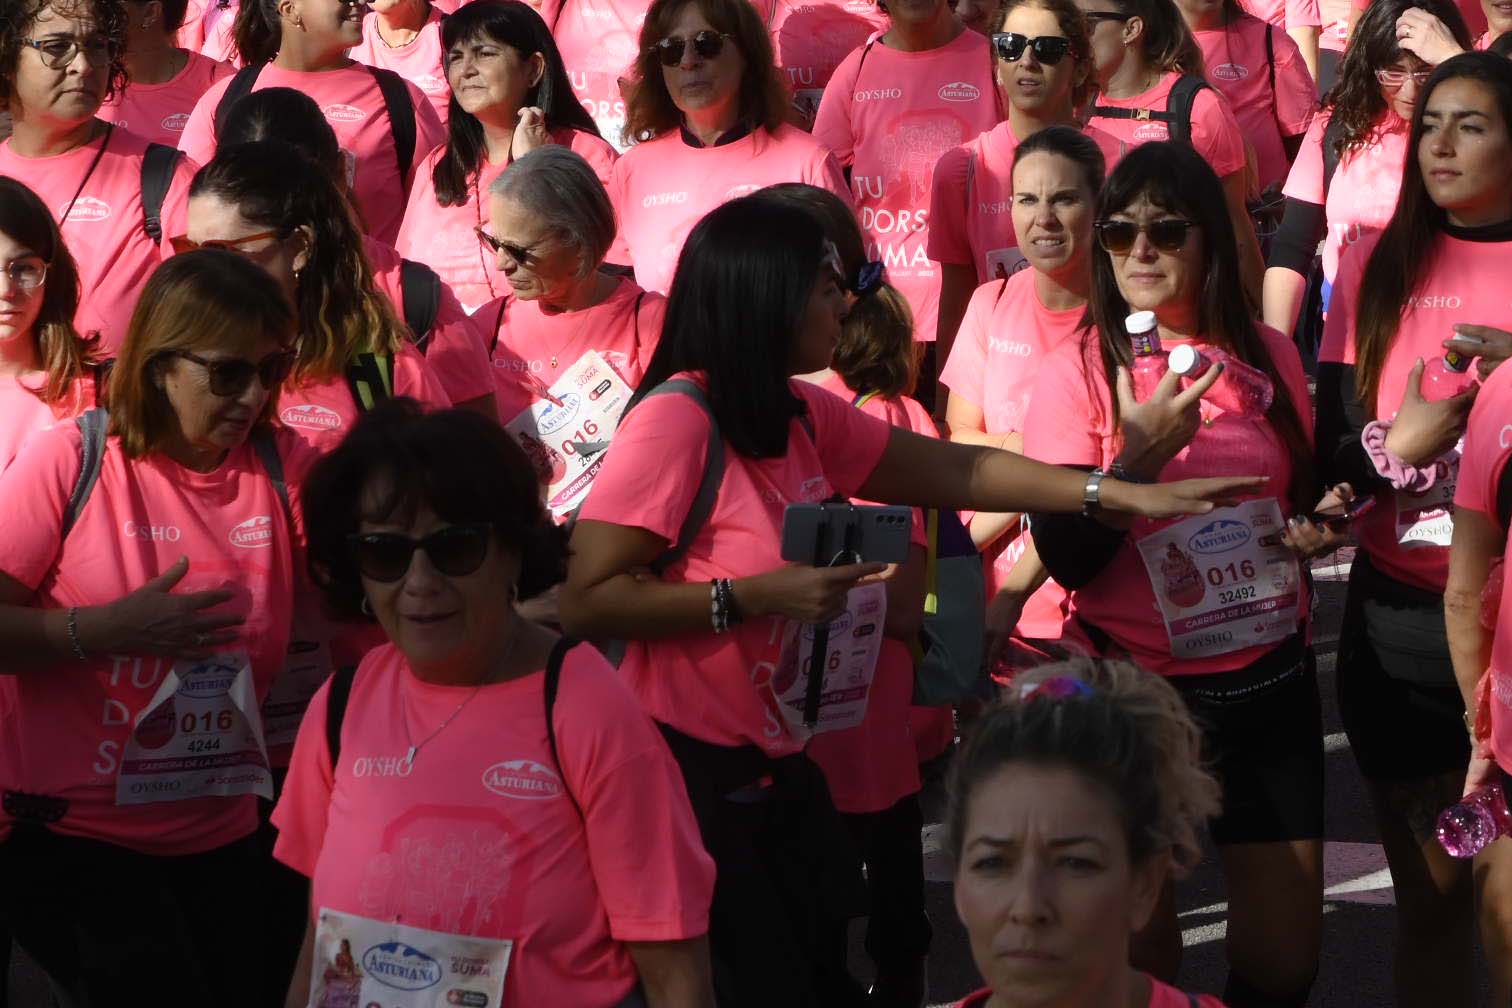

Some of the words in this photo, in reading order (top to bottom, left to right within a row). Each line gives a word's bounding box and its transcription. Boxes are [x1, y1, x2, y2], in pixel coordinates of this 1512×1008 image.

[787, 67, 813, 85] TU
[855, 87, 902, 103] OYSHO
[940, 86, 978, 97] ASTURIANA
[853, 175, 883, 198] TU
[642, 192, 687, 208] OYSHO
[862, 205, 929, 233] DORS
[494, 358, 543, 373] OYSHO
[285, 412, 337, 426] ASTURIANA
[561, 419, 598, 456] 016
[561, 474, 591, 502] CARRERA
[588, 464, 600, 478] DE
[1194, 529, 1249, 549] ASTURIANA
[1206, 559, 1256, 586] 016
[1219, 585, 1257, 605] 32492
[1185, 613, 1226, 629] CARRERA
[1228, 609, 1239, 618] DE
[1240, 606, 1251, 616] LA
[1185, 630, 1233, 651] OYSHO
[108, 657, 162, 690] TU
[181, 710, 233, 734] 016
[187, 738, 221, 752] 4244
[138, 758, 182, 770] CARRERA
[352, 756, 413, 778] OYSHO
[130, 781, 181, 793] OYSHO
[487, 772, 559, 793] ASTURIANA
[369, 955, 435, 983] ASTURIANA
[450, 962, 492, 976] SUMA
